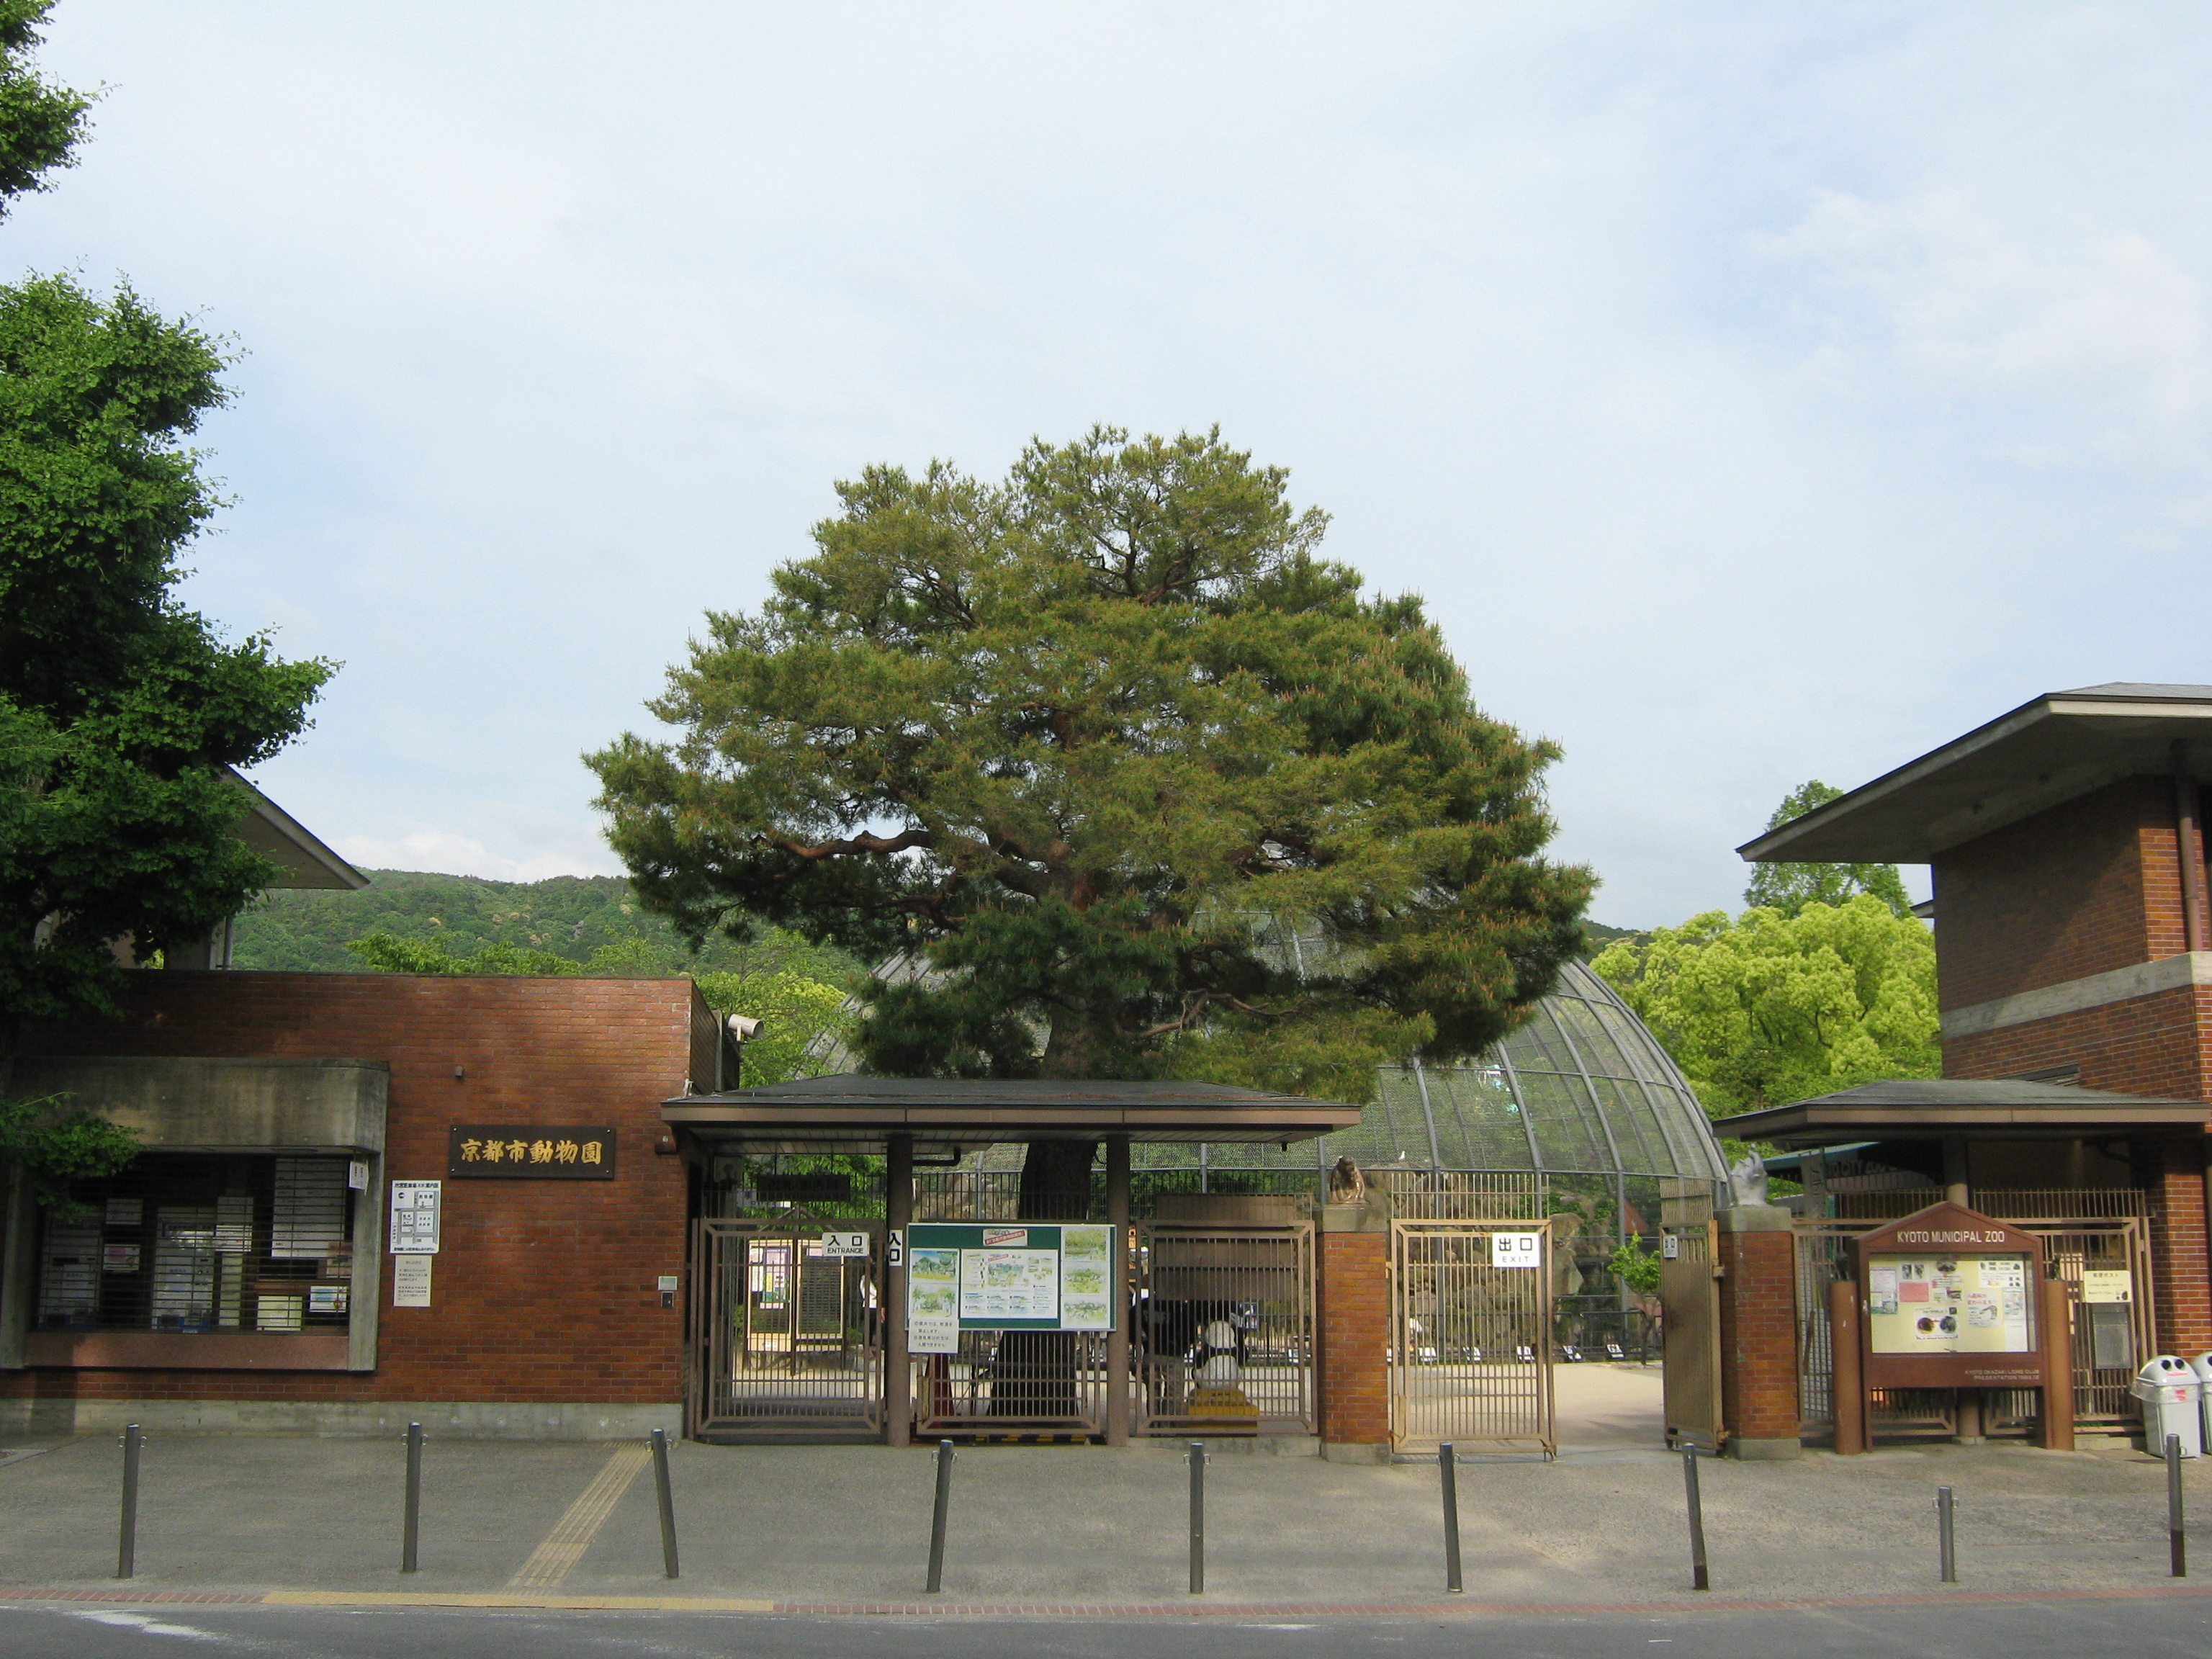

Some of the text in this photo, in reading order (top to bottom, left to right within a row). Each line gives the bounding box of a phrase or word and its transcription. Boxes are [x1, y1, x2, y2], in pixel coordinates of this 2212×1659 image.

[459, 1138, 603, 1164] 京都市動物園
[828, 1235, 863, 1246] 入口
[1498, 1237, 1532, 1251] 出口
[1897, 1231, 2005, 1243] KYOTO MUNICIPAL ZOO
[890, 1233, 901, 1262] 入口
